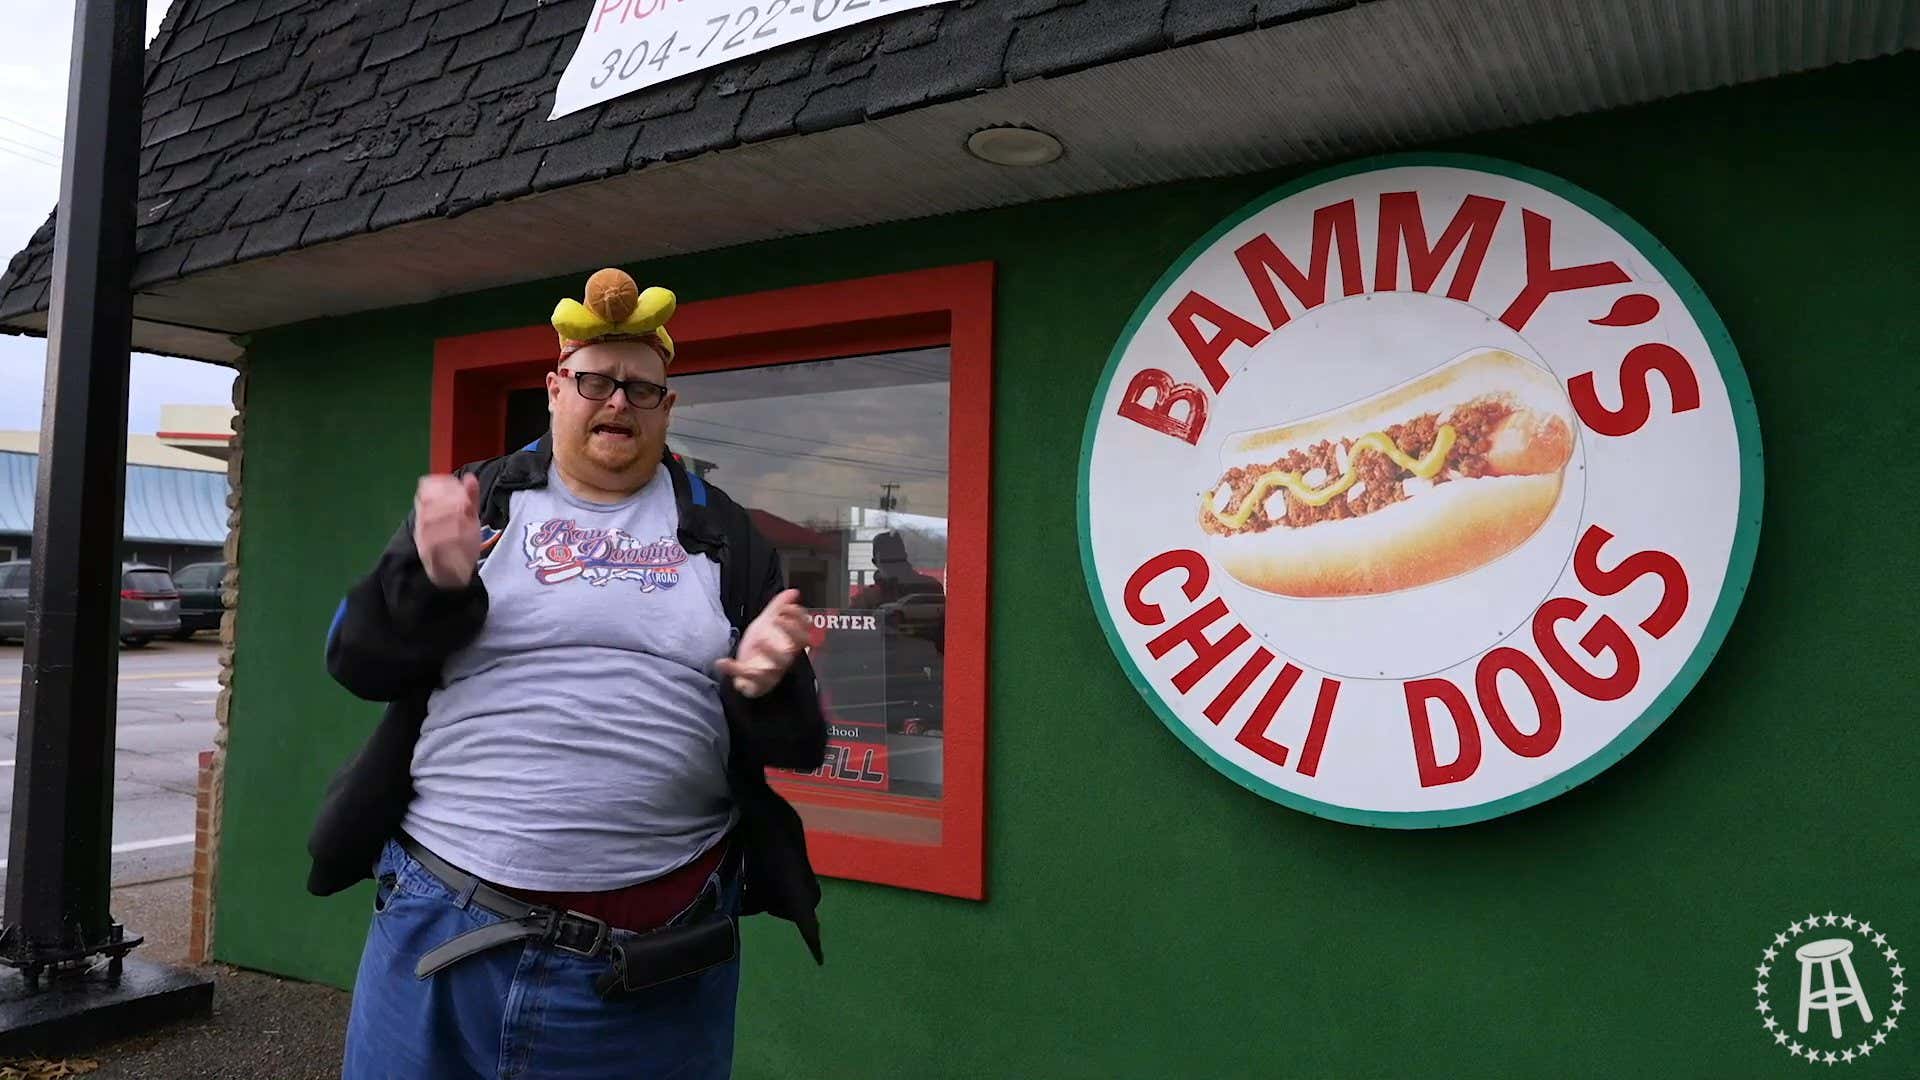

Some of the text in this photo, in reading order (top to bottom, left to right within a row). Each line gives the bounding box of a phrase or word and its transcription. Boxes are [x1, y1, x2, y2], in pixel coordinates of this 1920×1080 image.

[1117, 191, 1700, 446] BAMMY'S
[655, 572, 679, 583] ROAD
[1123, 524, 1689, 788] CHILI DOGS
[826, 725, 860, 738] chool
[793, 744, 885, 784] ALL
